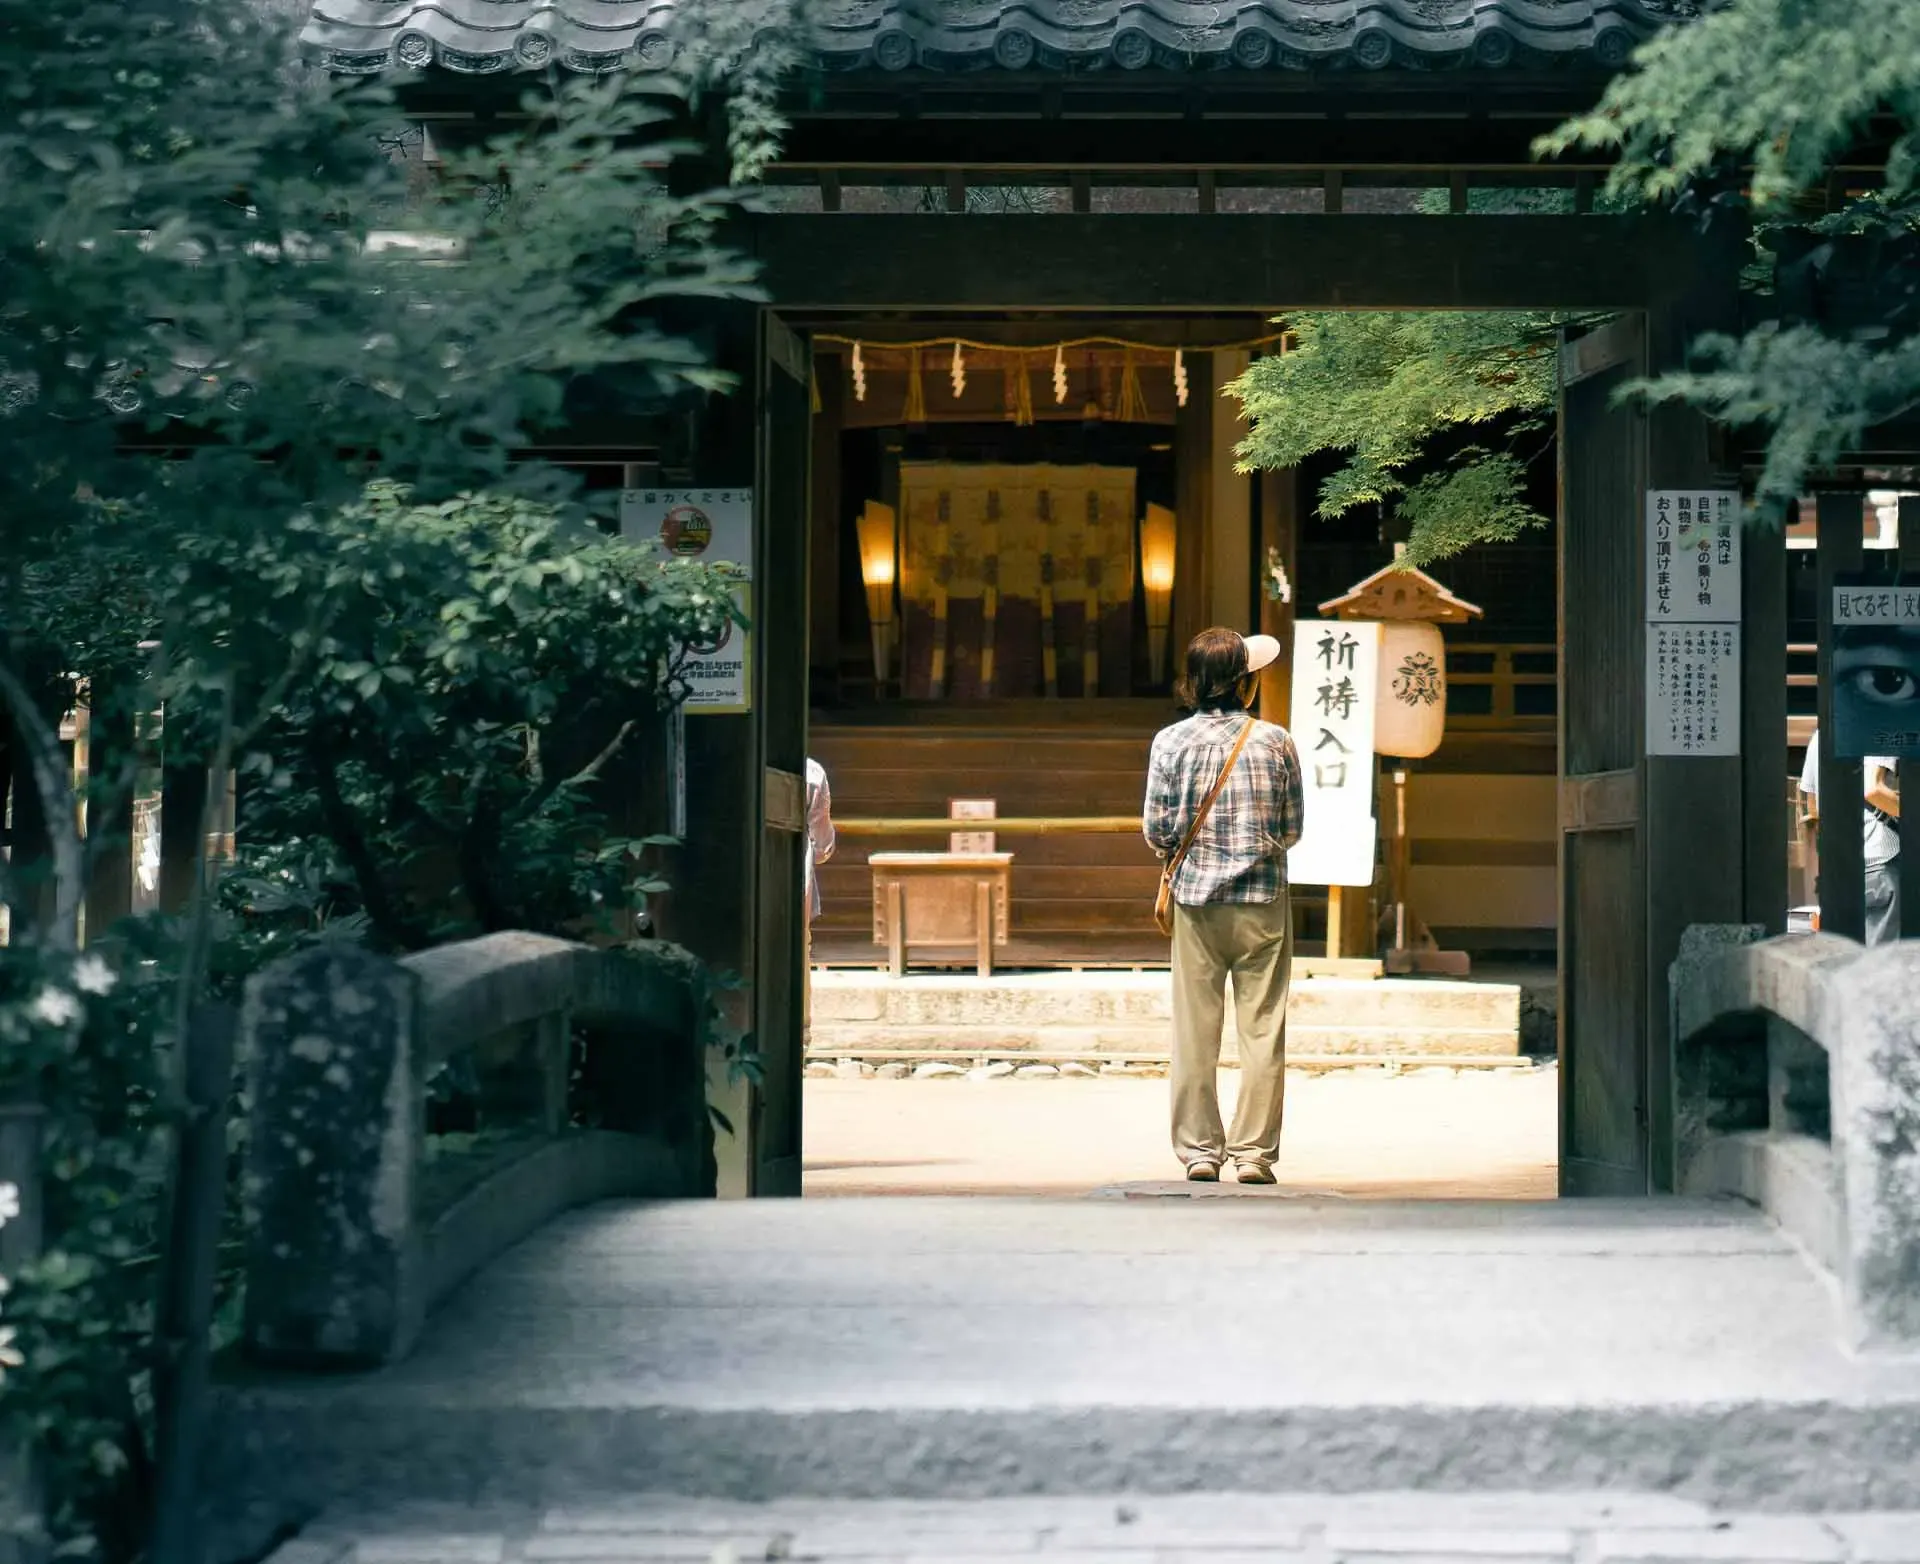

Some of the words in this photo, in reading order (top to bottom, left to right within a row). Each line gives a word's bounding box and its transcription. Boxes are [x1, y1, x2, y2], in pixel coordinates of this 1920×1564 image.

[625, 492, 752, 504] ご協力ください
[1697, 496, 1711, 605] 自転の乗り物
[1656, 496, 1671, 614] お入り頂けません
[1839, 593, 1920, 618] 見てるぞ！文
[1313, 629, 1360, 790] 祈祷入口
